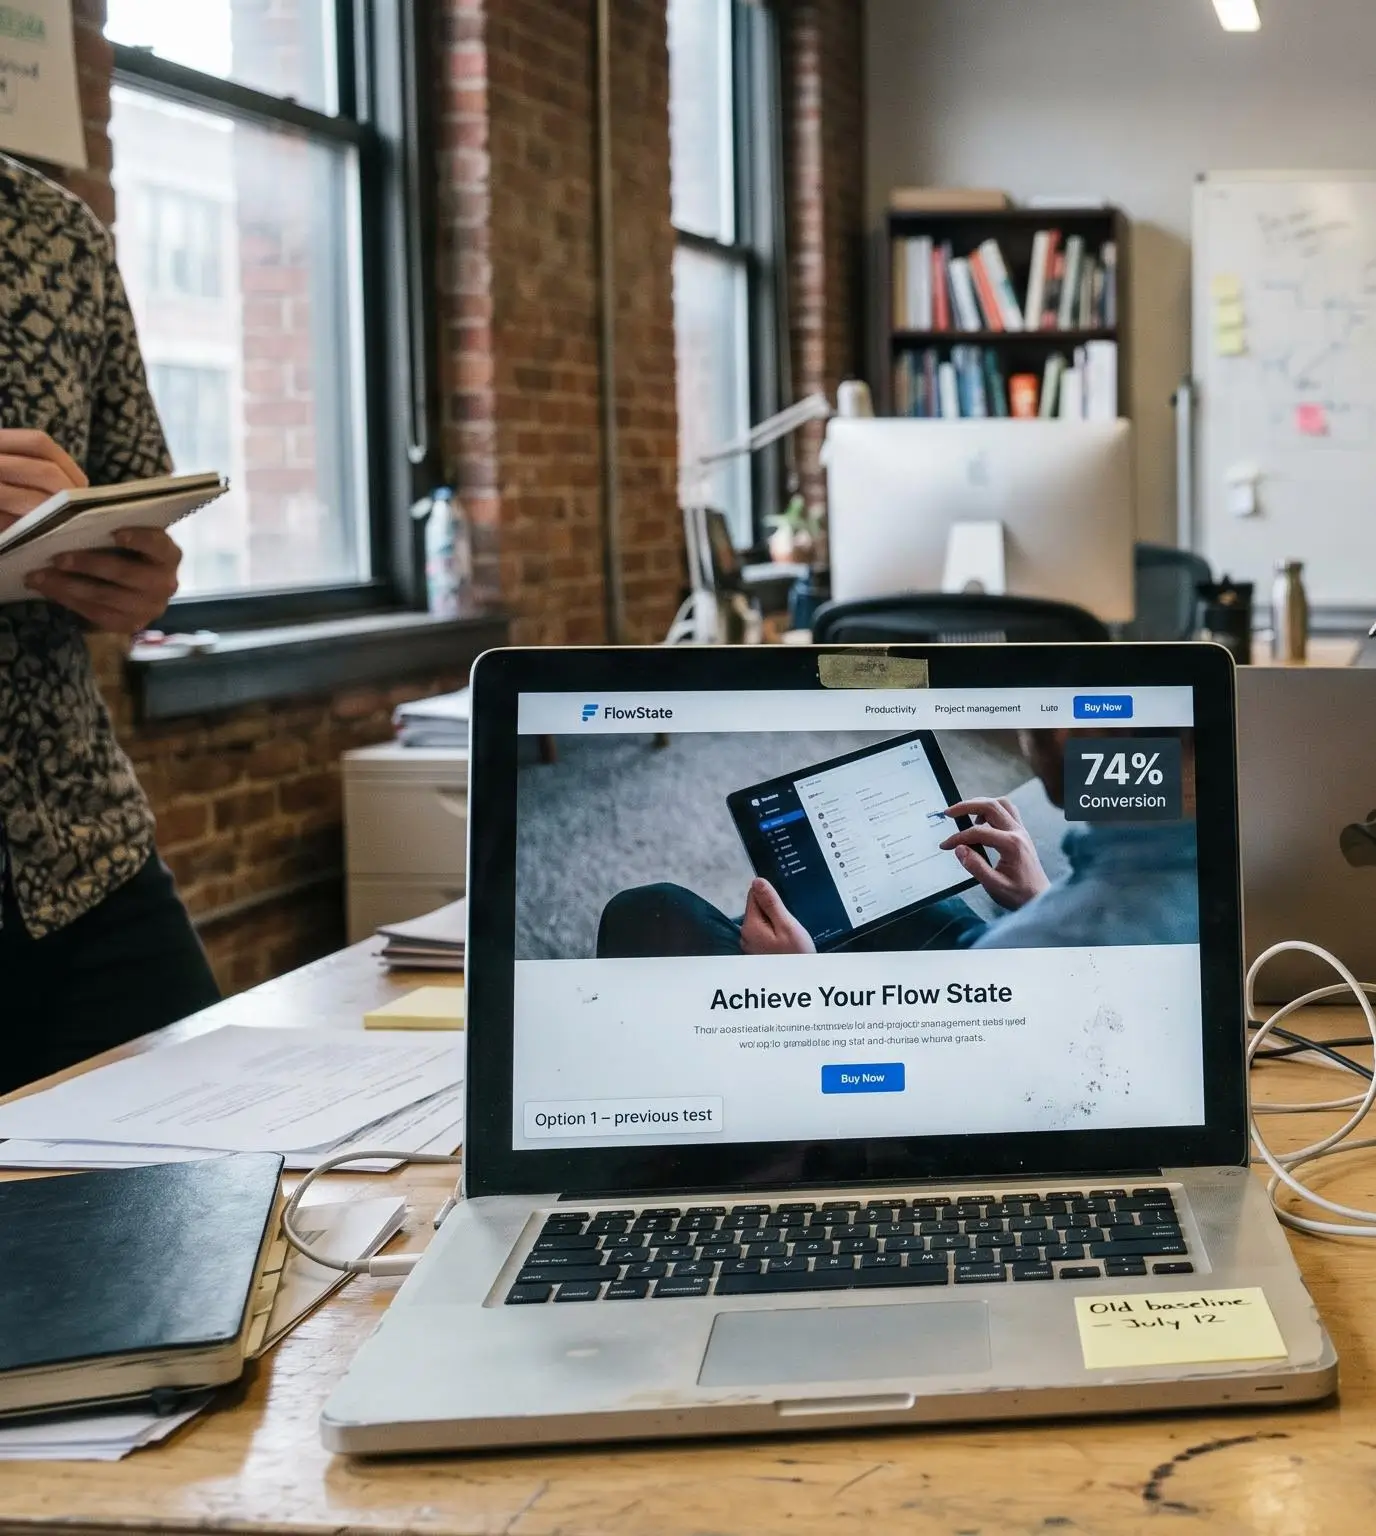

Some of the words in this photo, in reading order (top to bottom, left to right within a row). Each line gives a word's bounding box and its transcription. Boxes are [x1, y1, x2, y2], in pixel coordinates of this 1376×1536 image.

[605, 707, 672, 719] FlowState
[866, 706, 916, 715] Productivity
[935, 705, 965, 714] Project
[967, 705, 1020, 713] management
[1085, 703, 1100, 713] Buy
[1082, 753, 1163, 785] 74%
[1080, 794, 1165, 807] Conversion
[710, 988, 811, 1009] Achieve
[818, 987, 875, 1006] Your
[883, 985, 940, 1005] Flow
[947, 983, 1012, 1003] State
[842, 1075, 860, 1084] Buy
[863, 1074, 884, 1082] Now
[536, 1113, 585, 1129] Option
[591, 1112, 596, 1124] 1
[615, 1110, 678, 1126] previous
[683, 1109, 712, 1121] test
[1090, 1302, 1133, 1313] Old
[1145, 1298, 1250, 1310] baseline
[1122, 1317, 1180, 1330] July
[1194, 1314, 1224, 1324] 12
